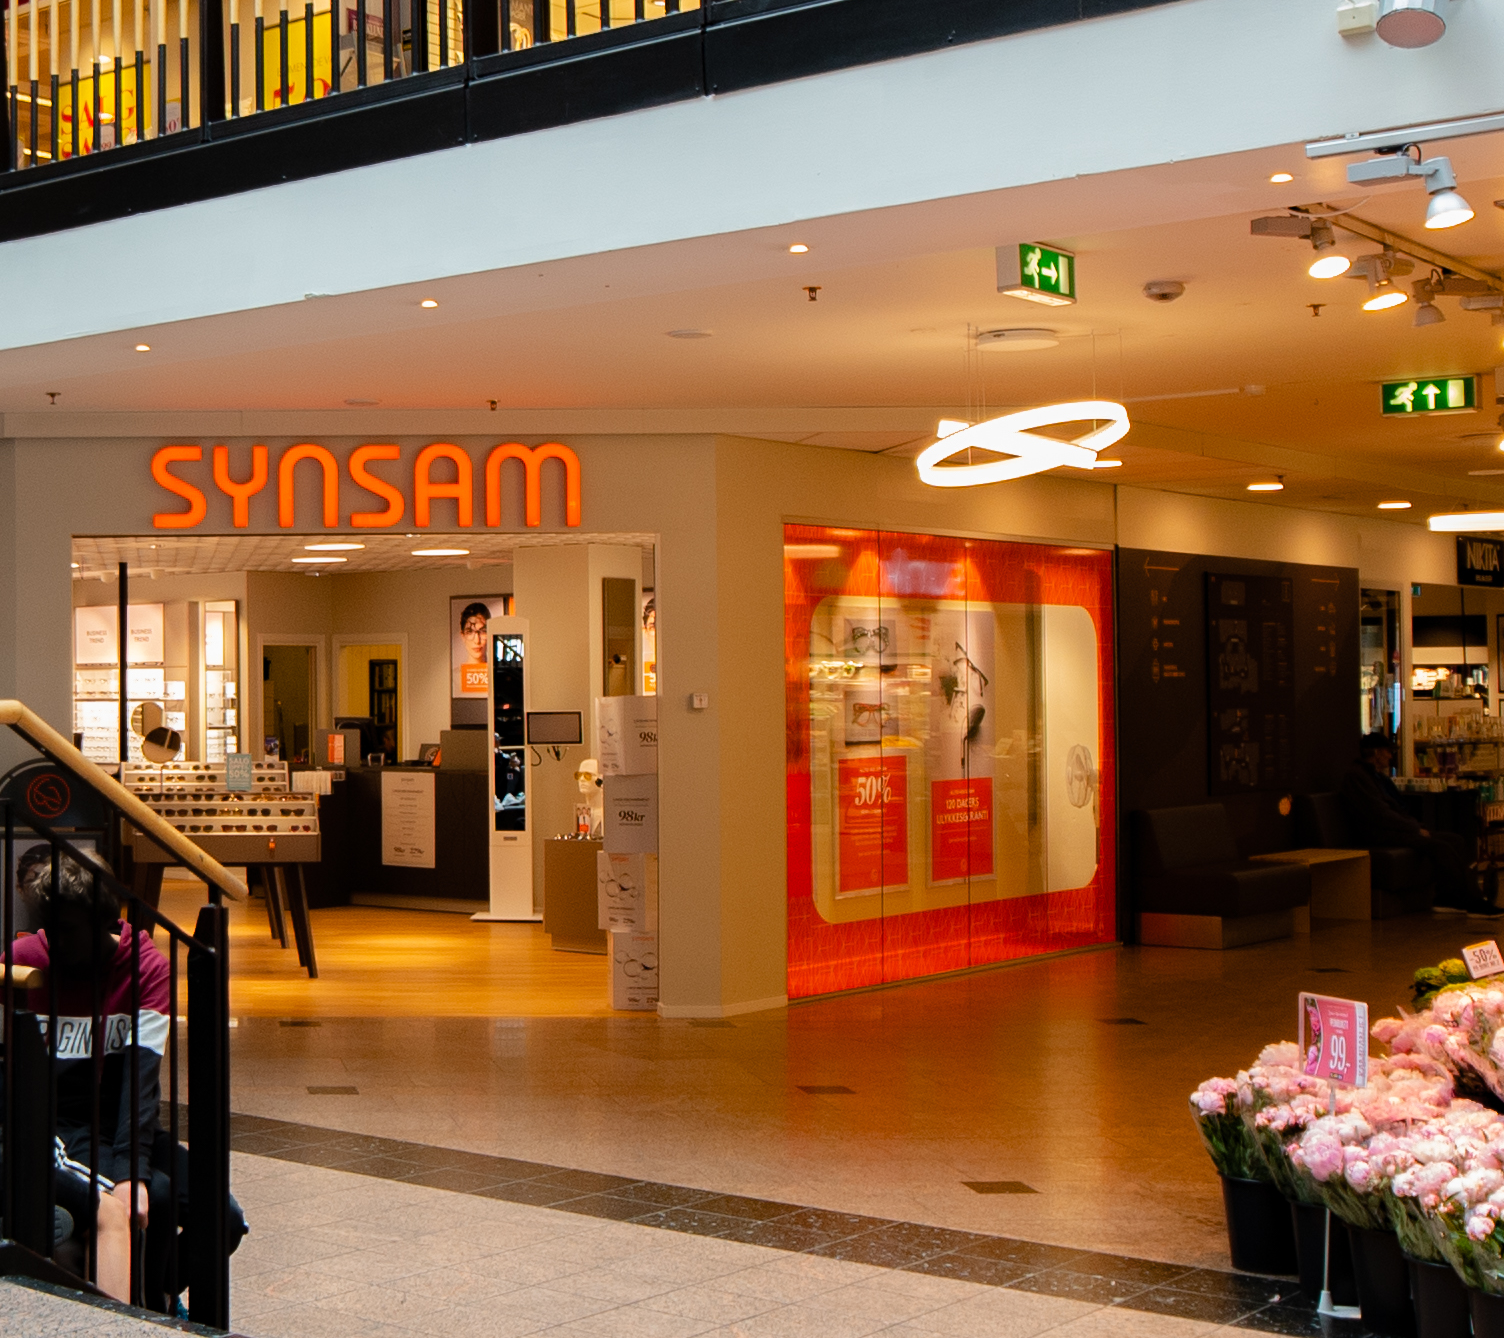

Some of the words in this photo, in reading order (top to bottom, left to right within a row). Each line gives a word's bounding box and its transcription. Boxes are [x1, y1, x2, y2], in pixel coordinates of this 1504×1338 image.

[150, 442, 582, 529] SYNSAM
[1466, 540, 1500, 572] NIKITA
[854, 772, 892, 807] 50%
